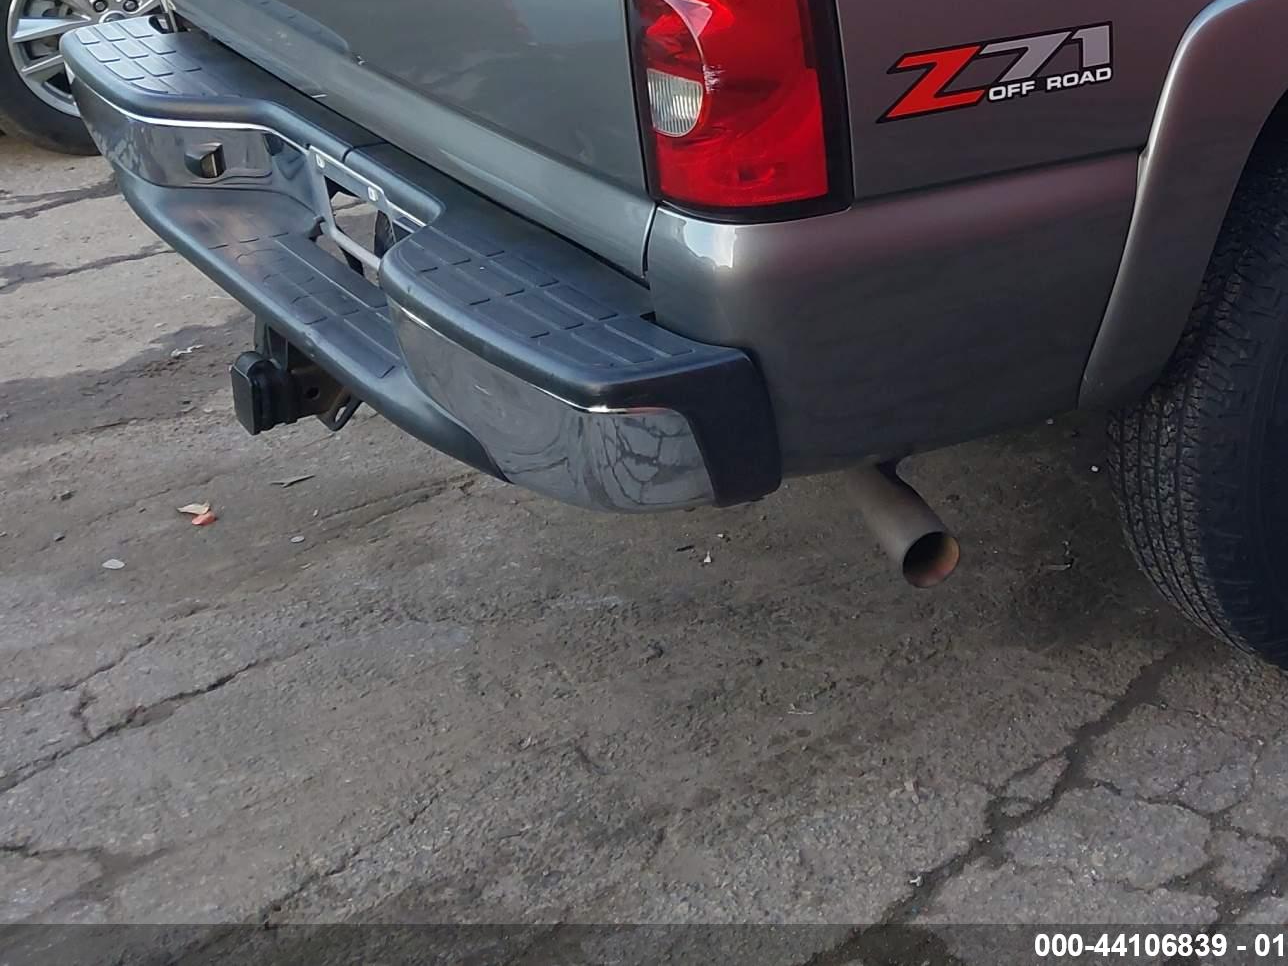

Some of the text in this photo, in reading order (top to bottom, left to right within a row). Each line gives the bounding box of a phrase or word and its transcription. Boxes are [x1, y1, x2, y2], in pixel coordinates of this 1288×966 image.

[878, 22, 1112, 122] Z71
[988, 66, 1113, 102] OFF ROAD
